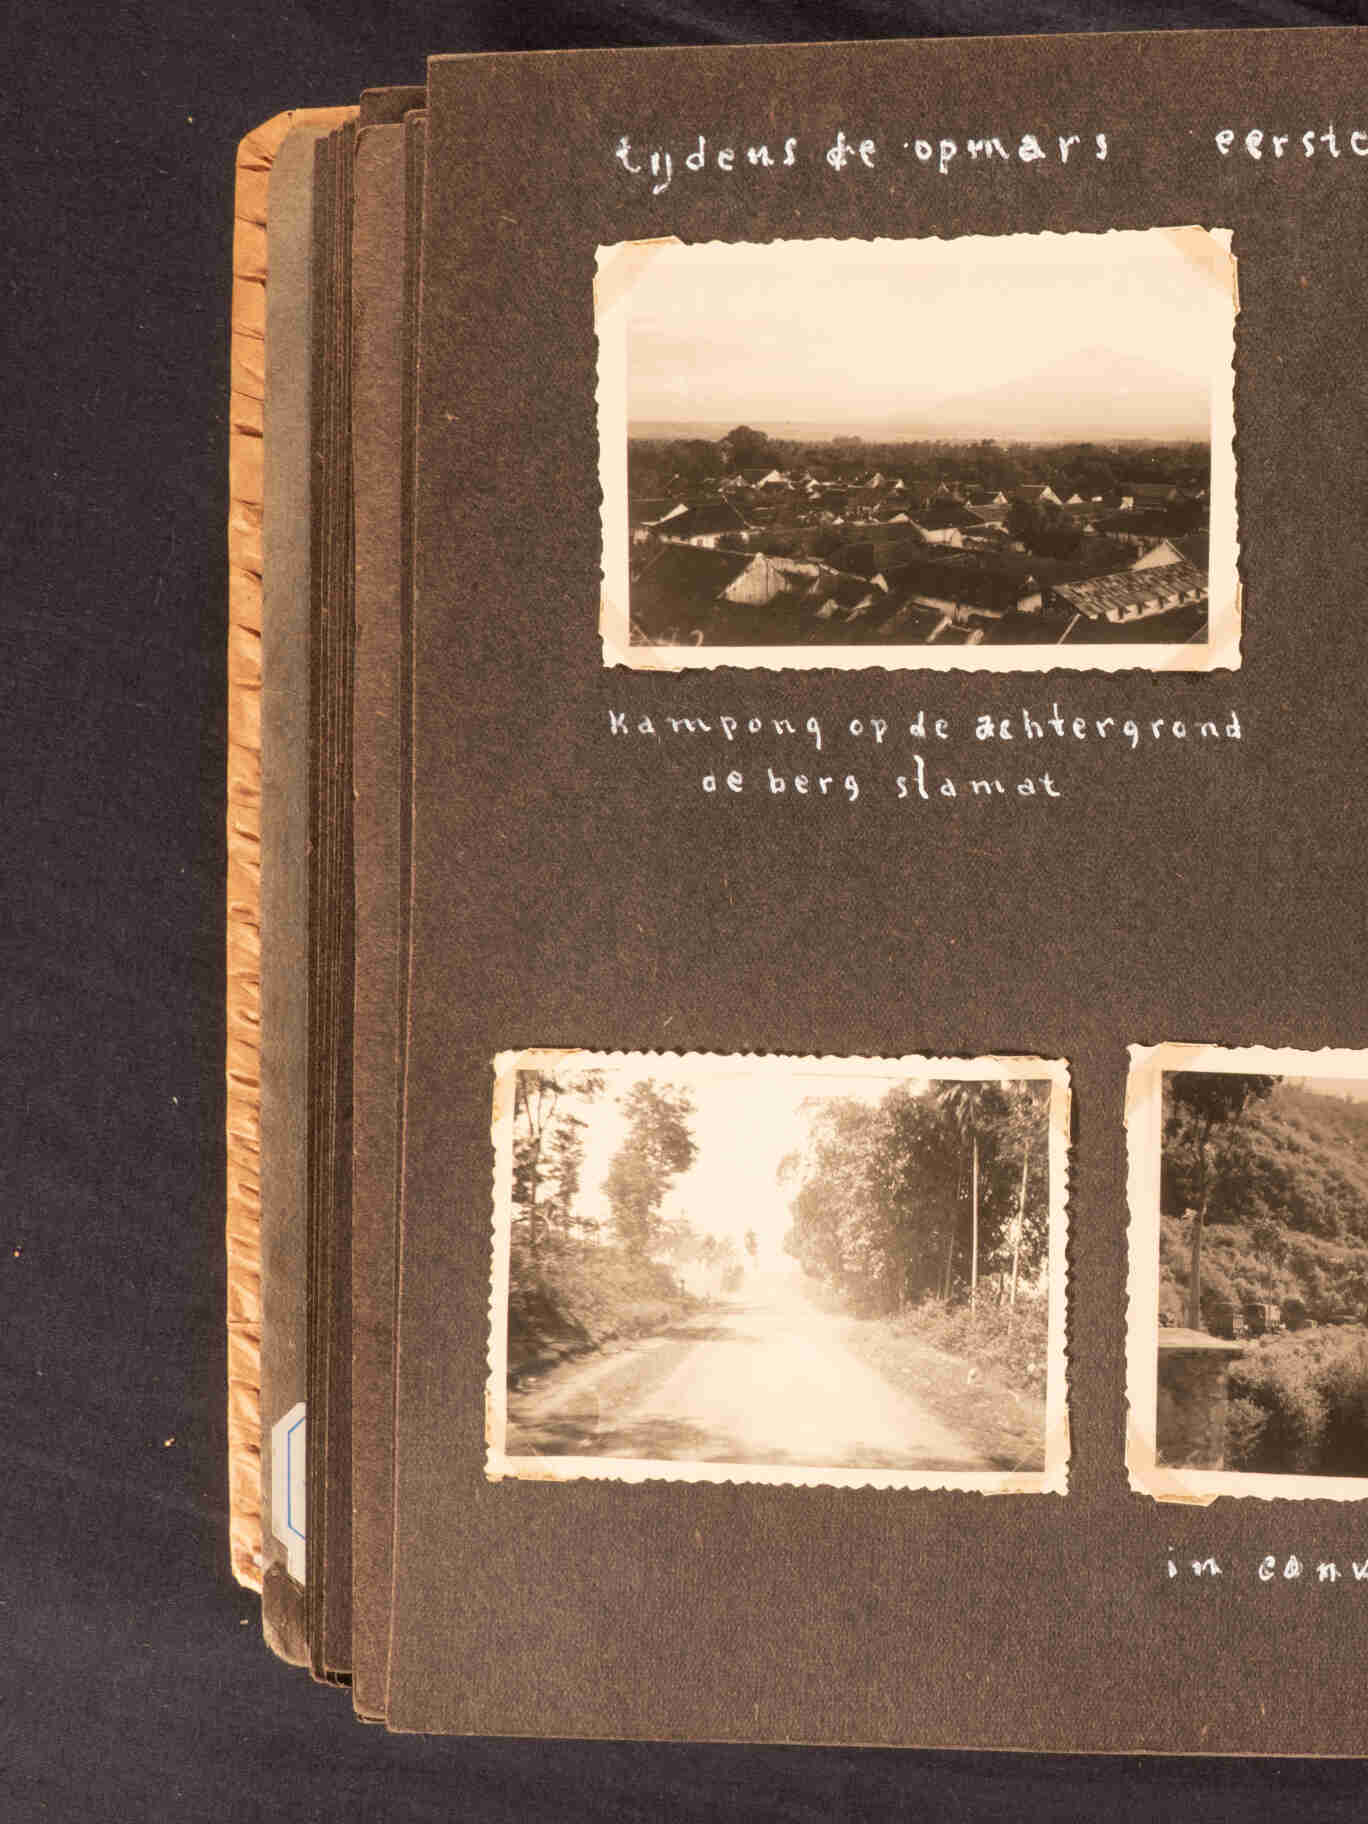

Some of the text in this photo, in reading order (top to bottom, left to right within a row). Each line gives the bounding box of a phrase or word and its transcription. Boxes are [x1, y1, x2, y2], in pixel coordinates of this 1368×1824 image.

[825, 130, 877, 172] de
[913, 132, 1109, 176] opmars
[848, 717, 889, 744] op
[908, 710, 949, 741] de
[974, 701, 1243, 750] achtergrond
[767, 767, 860, 803] berg
[895, 753, 1062, 800] slamat
